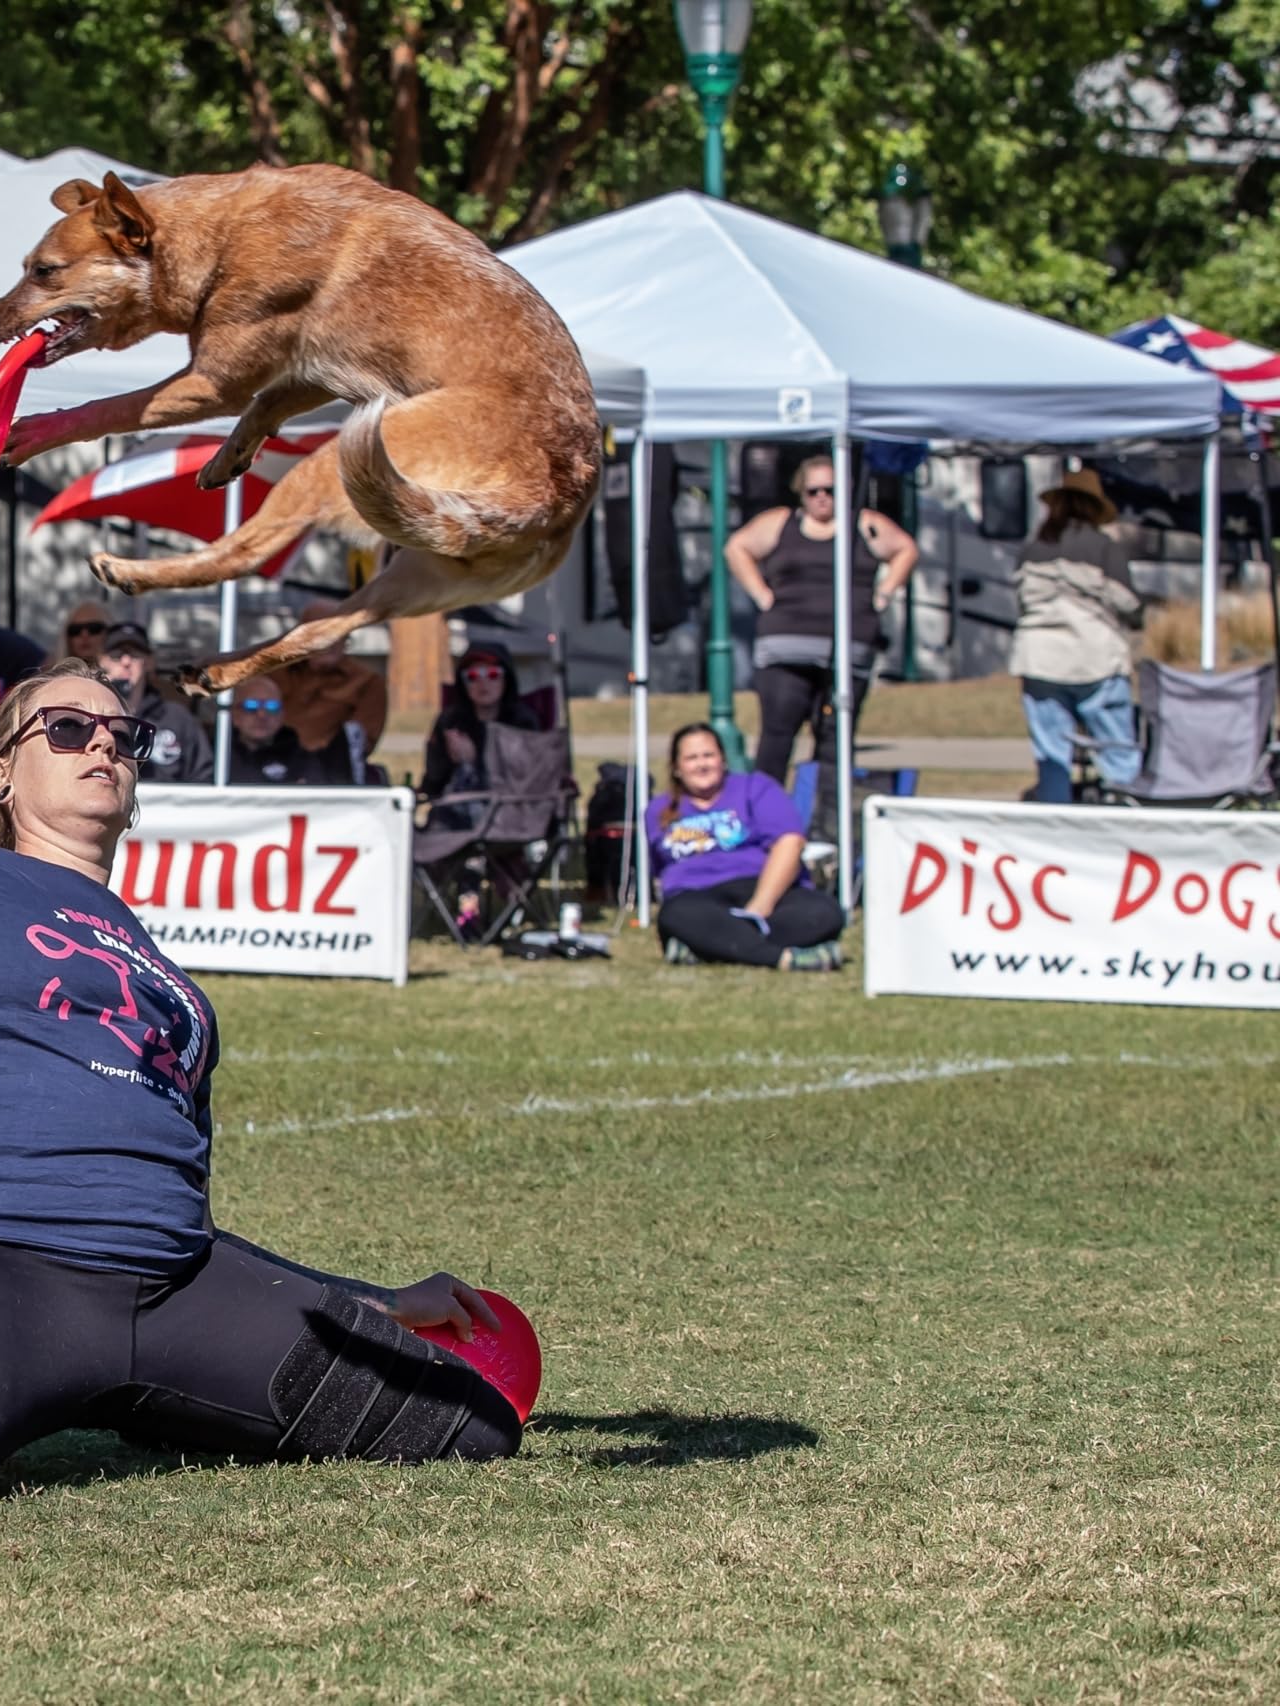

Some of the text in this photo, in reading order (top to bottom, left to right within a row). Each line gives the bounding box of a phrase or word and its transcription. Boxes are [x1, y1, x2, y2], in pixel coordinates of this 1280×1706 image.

[60, 907, 133, 944] WORLD
[140, 914, 373, 952] HAMPIONSHIP
[90, 1060, 154, 1087] Hyperflite
